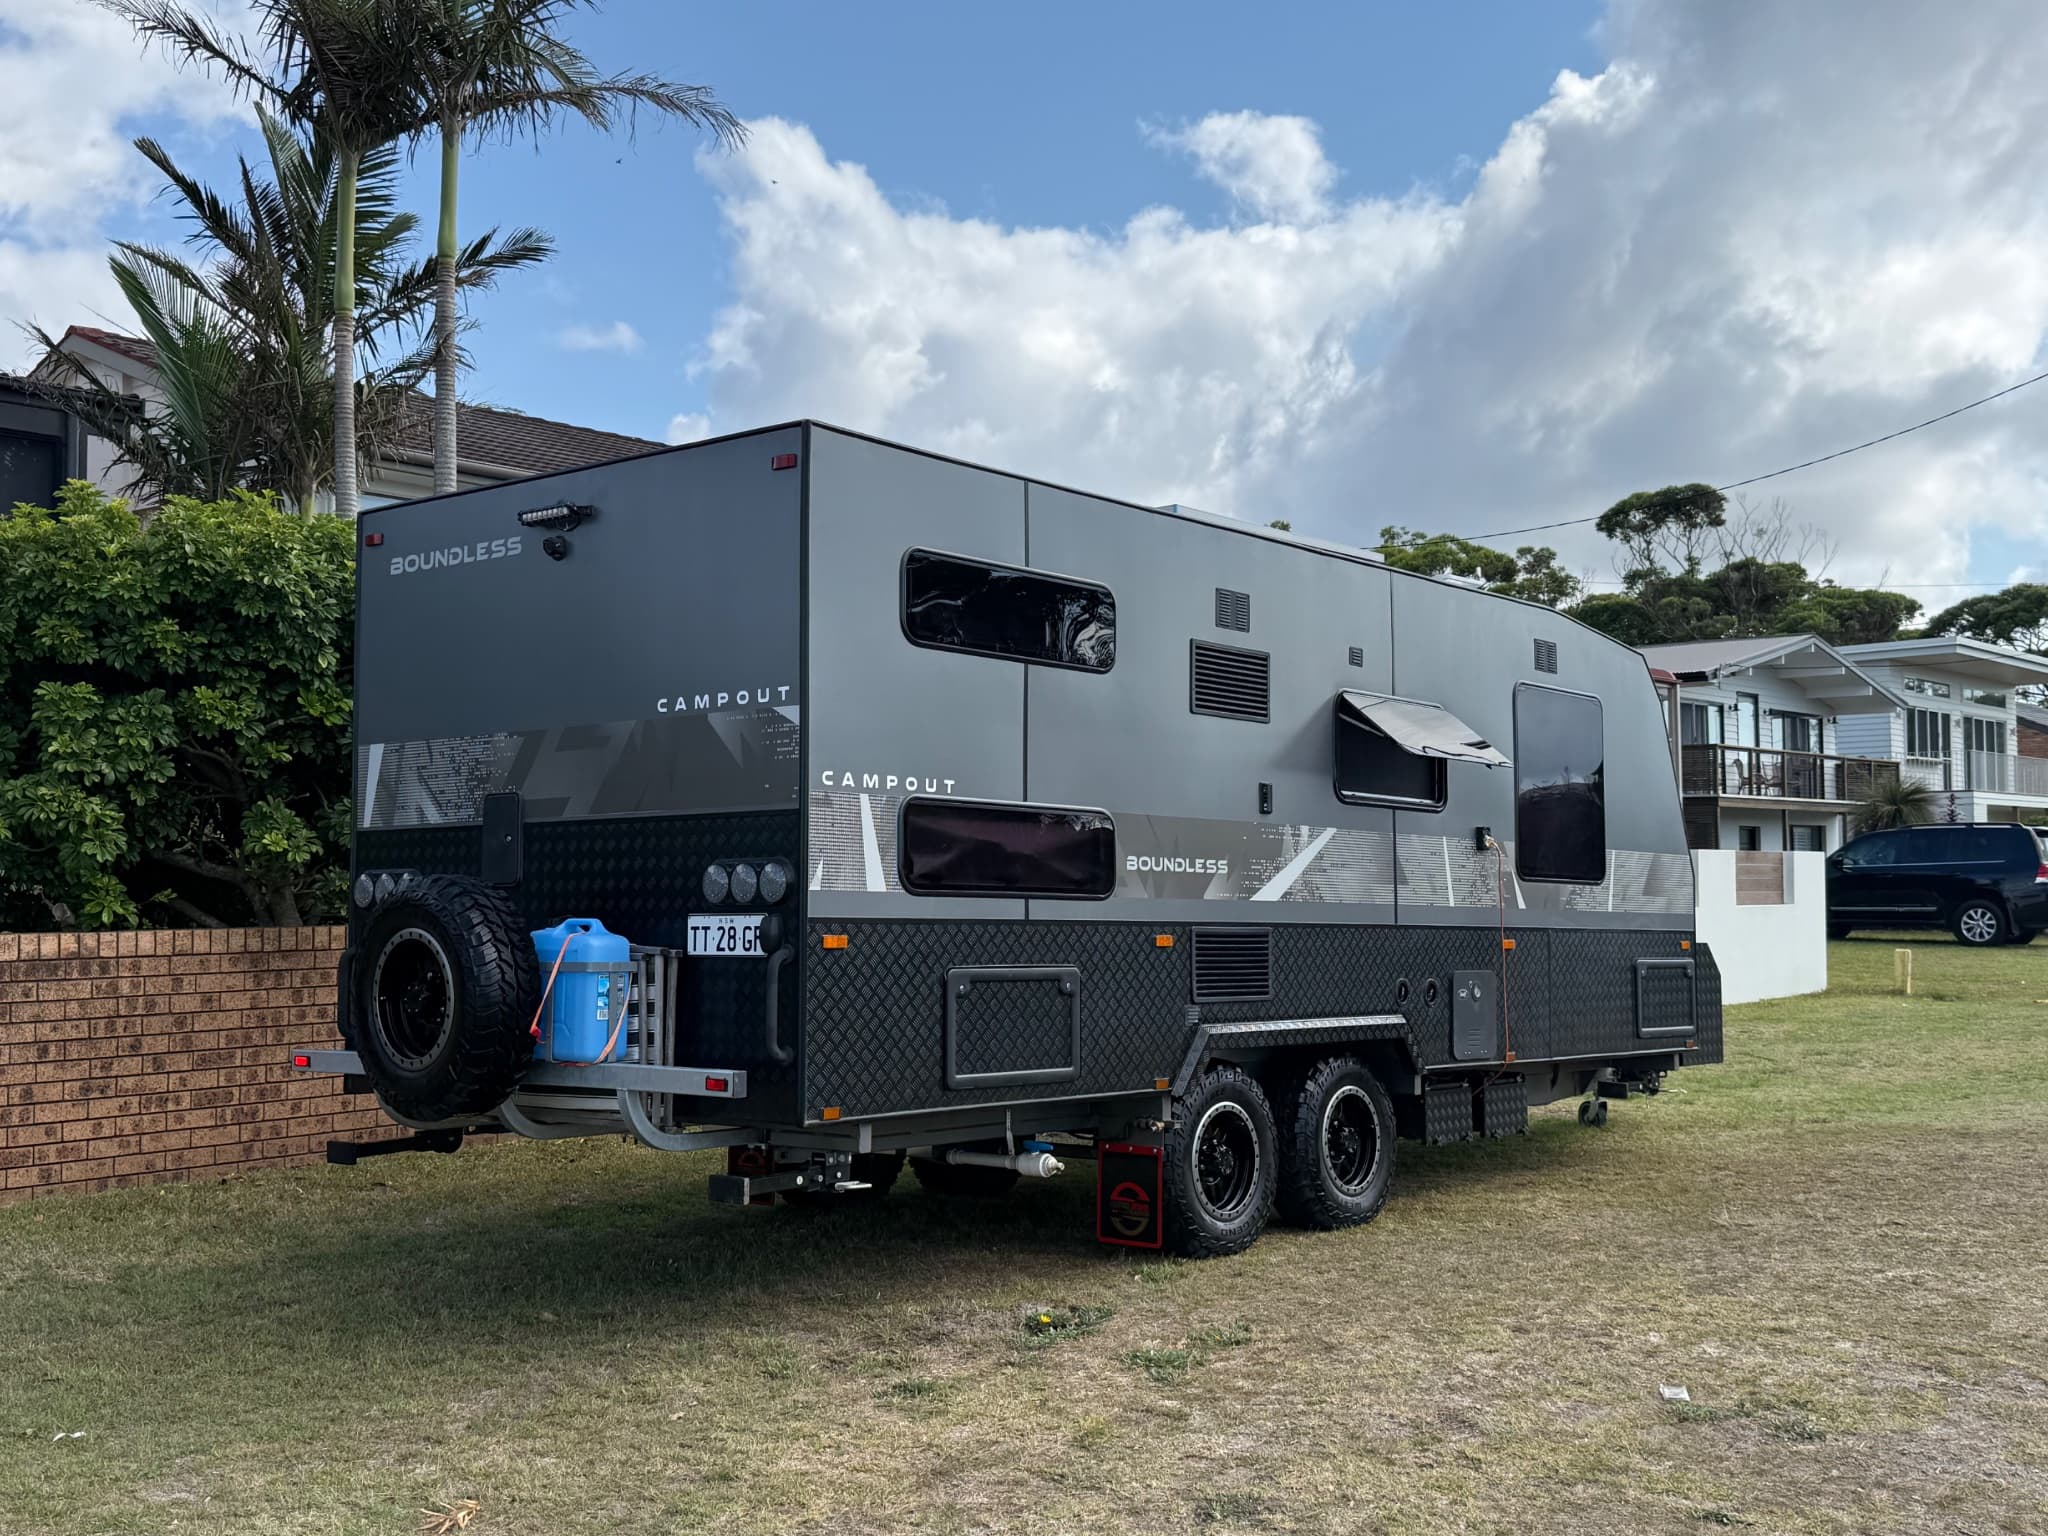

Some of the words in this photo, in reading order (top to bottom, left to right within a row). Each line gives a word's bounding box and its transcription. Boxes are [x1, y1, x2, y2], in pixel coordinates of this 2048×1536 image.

[390, 536, 522, 576] BOUNDLESS
[656, 685, 791, 713] CAMPOUT
[821, 770, 955, 794] CAMPOUT
[1126, 855, 1229, 874] BOUNDLESS
